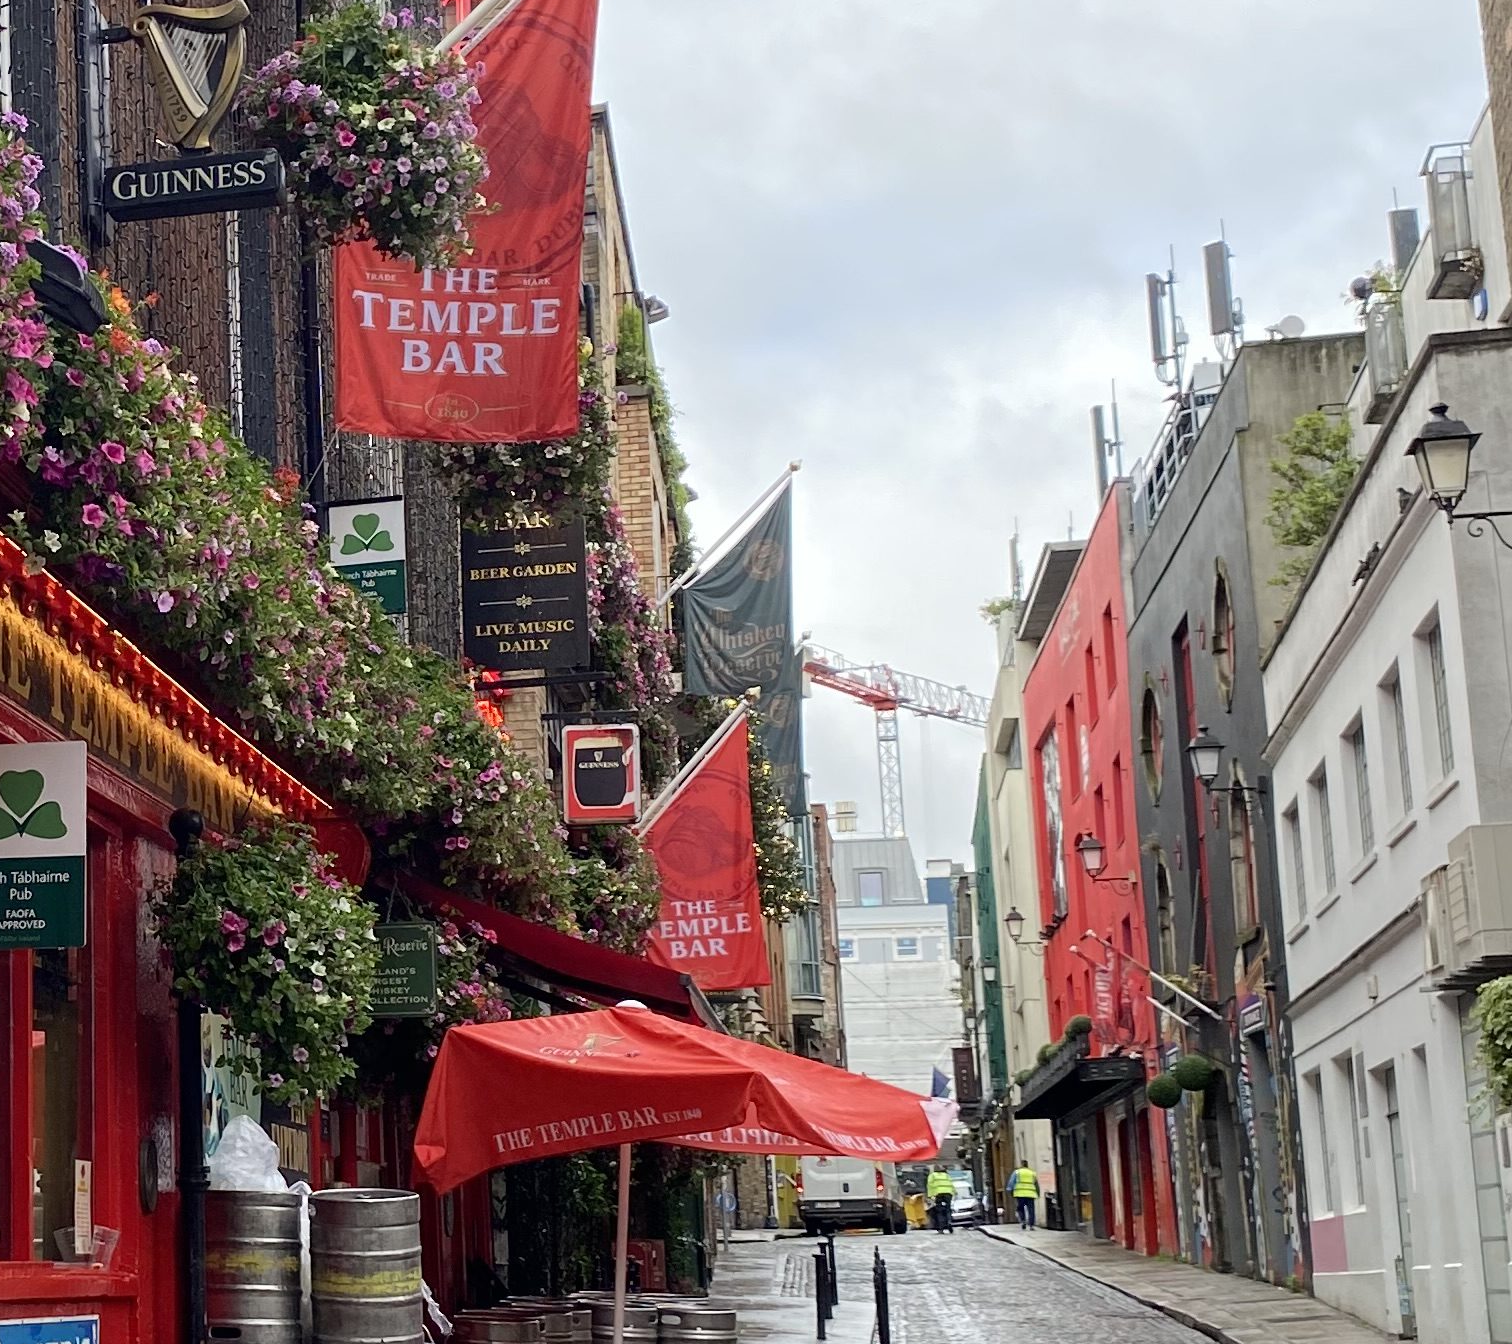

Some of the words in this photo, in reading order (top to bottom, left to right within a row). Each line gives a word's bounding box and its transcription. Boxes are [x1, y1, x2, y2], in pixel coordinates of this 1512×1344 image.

[112, 159, 266, 200] GUINNESS
[366, 271, 397, 283] TRADE
[421, 267, 499, 295] THE
[523, 277, 551, 287] MARK
[352, 289, 561, 337] TEMPLE
[401, 338, 508, 377] BAR
[470, 568, 510, 581] BEER
[513, 562, 578, 578] GARDEN
[361, 579, 376, 588] Pub
[475, 623, 515, 637] LIVE
[518, 619, 575, 634] MUSIC
[499, 639, 552, 653] DAILY
[578, 761, 619, 770] GUINNESS
[10, 887, 33, 900] Pub
[671, 899, 718, 918] THE
[670, 937, 729, 960] BAR
[370, 996, 429, 1004] OLLECTION
[493, 1127, 535, 1153] THE
[535, 1111, 617, 1145] TEMPLE
[618, 1106, 661, 1131] BAR
[661, 1110, 682, 1124] EST
[683, 1106, 704, 1121] 1840
